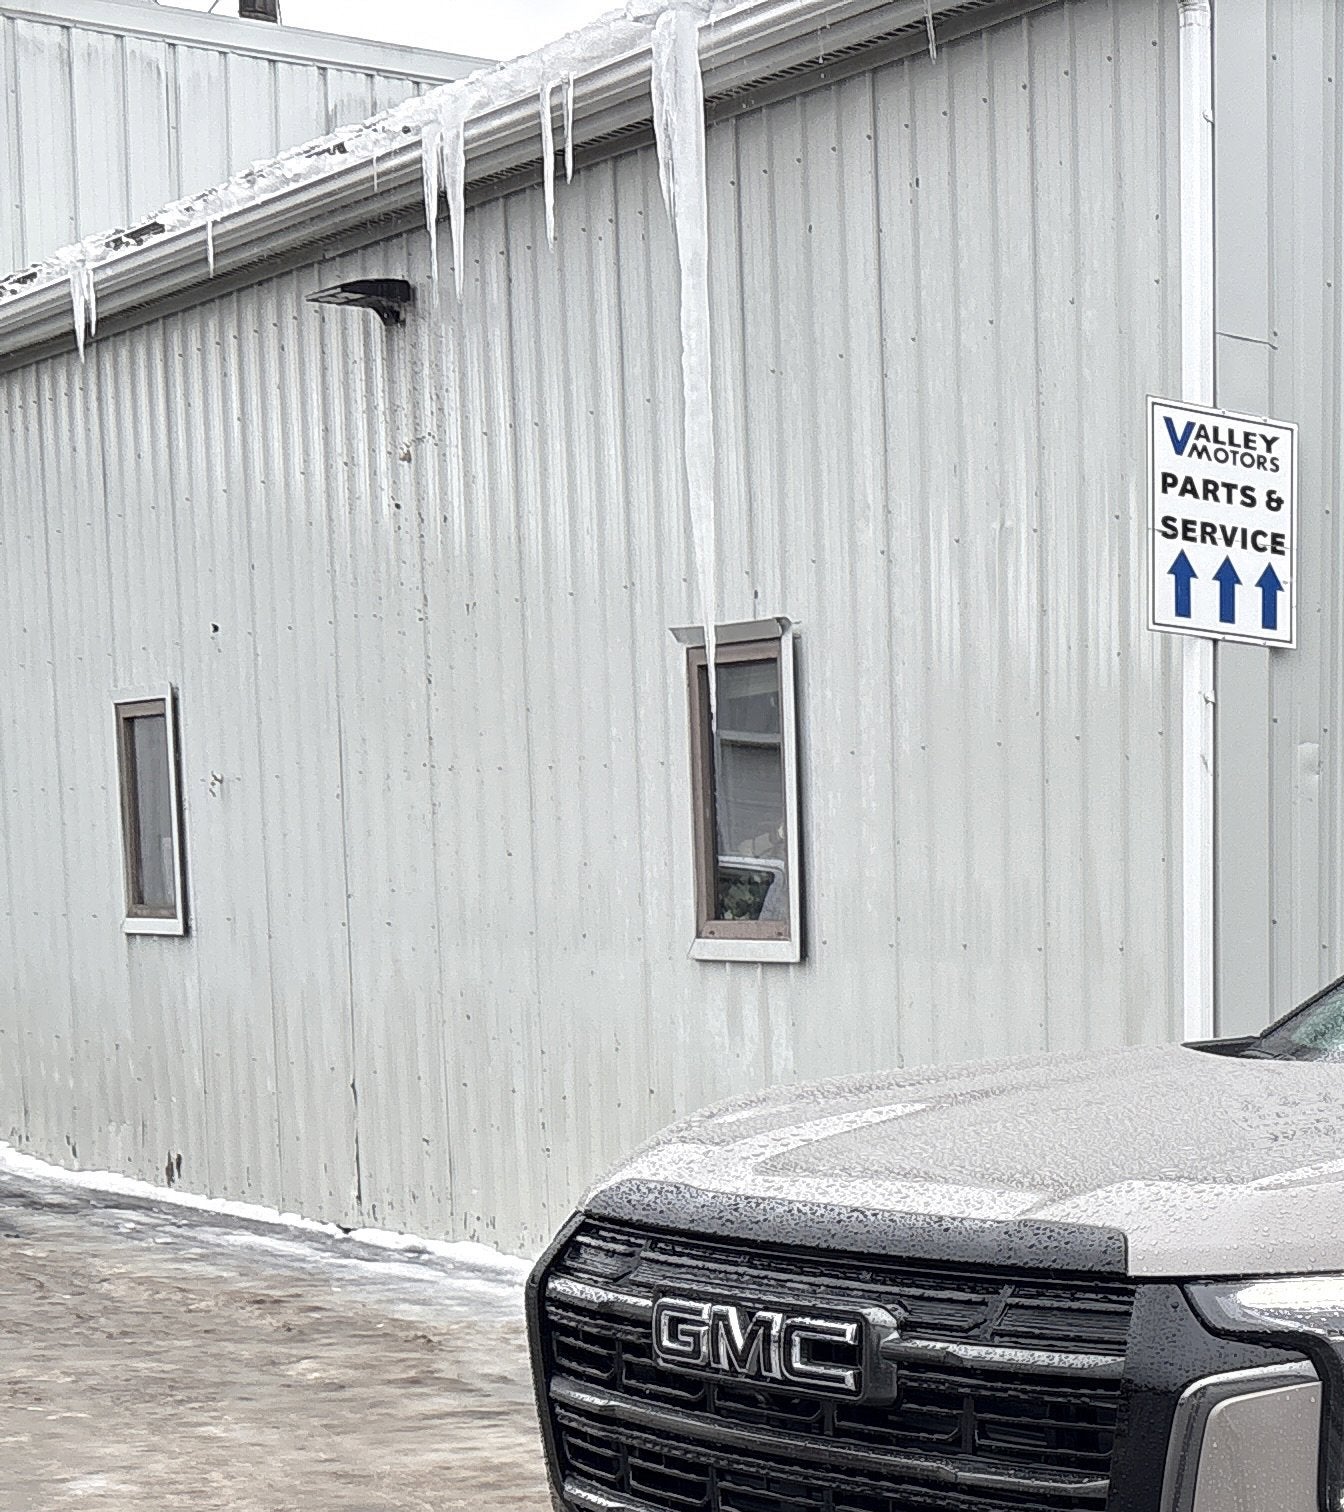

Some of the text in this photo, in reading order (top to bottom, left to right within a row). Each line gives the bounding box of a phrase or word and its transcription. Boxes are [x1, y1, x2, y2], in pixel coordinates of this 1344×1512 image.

[1163, 416, 1280, 456] VALLEY
[1187, 442, 1280, 473] MOTORS
[1161, 471, 1285, 512] PARTS &
[1161, 515, 1286, 556] SERVICE
[652, 1298, 861, 1391] GMC
